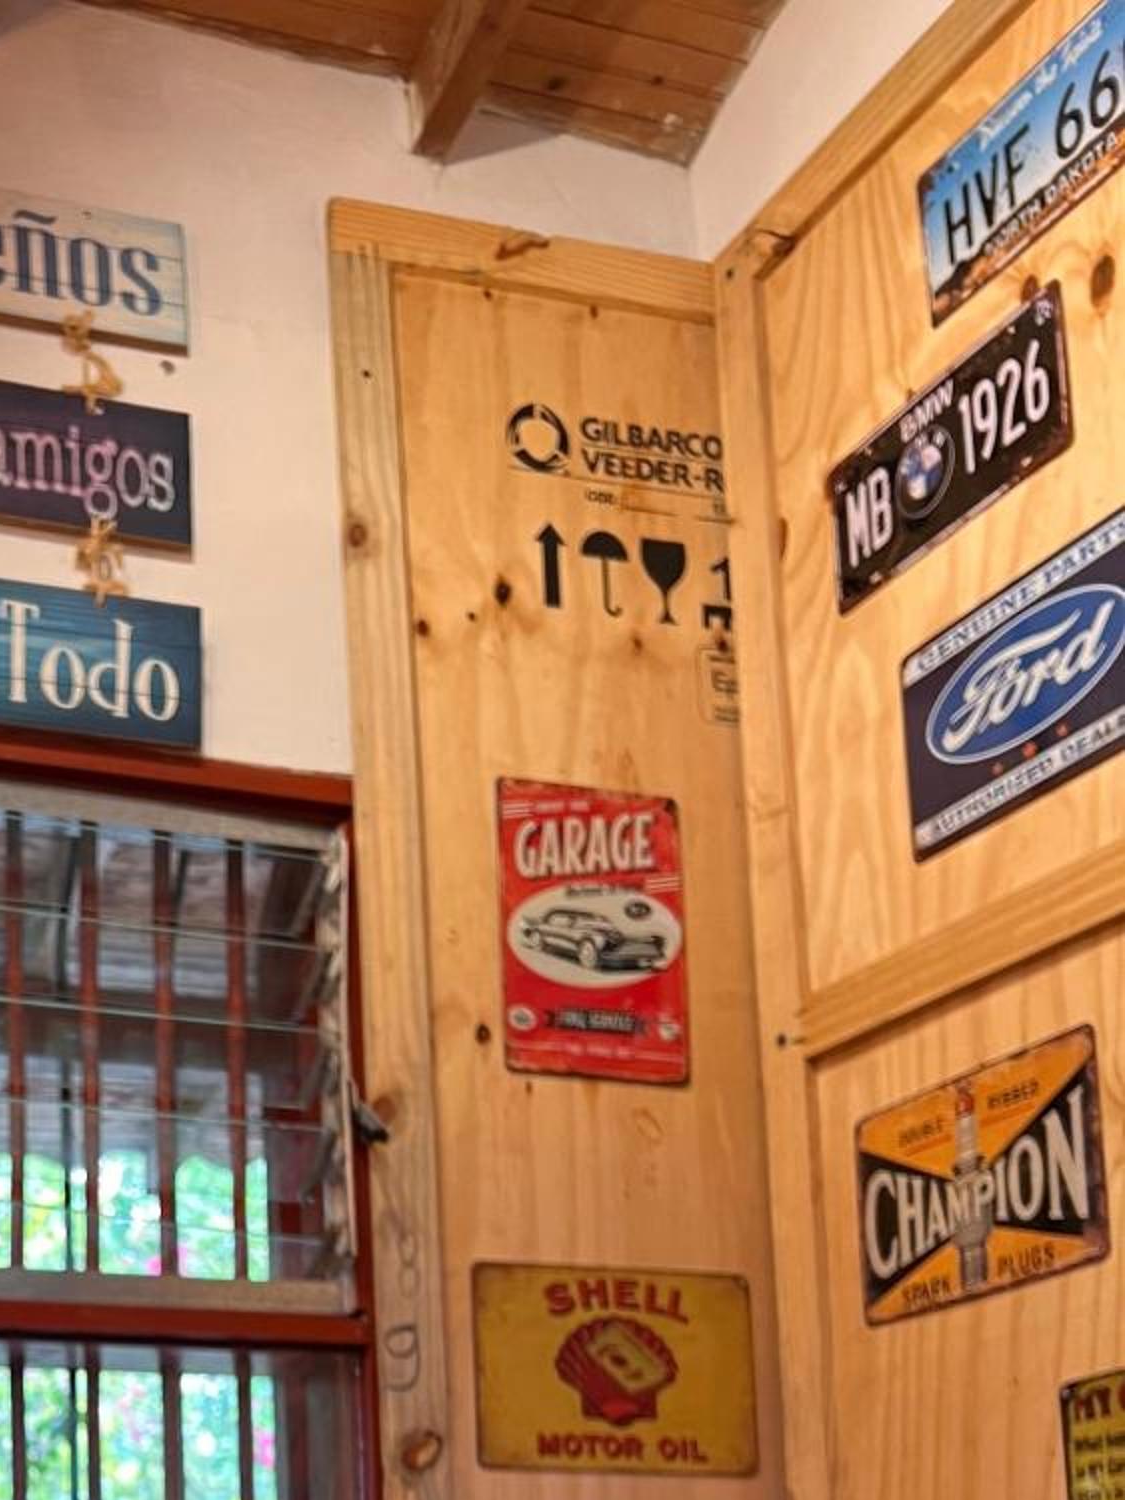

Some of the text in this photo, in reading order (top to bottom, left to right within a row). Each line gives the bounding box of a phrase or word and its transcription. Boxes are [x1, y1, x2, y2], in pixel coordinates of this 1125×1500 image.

[942, 122, 1031, 266] HVF
[1043, 130, 1119, 206] DAKOTA
[579, 415, 723, 462] GILBARCO
[899, 376, 956, 443] BMW
[845, 338, 1052, 569] MB 1926
[941, 599, 1115, 754] Ford
[512, 813, 656, 880] GARAGE
[864, 1083, 1091, 1280] CHAMPION
[996, 1241, 1055, 1278] PLUGS
[542, 1277, 690, 1325] SHELL
[536, 1431, 709, 1464] MOTOR OIL
